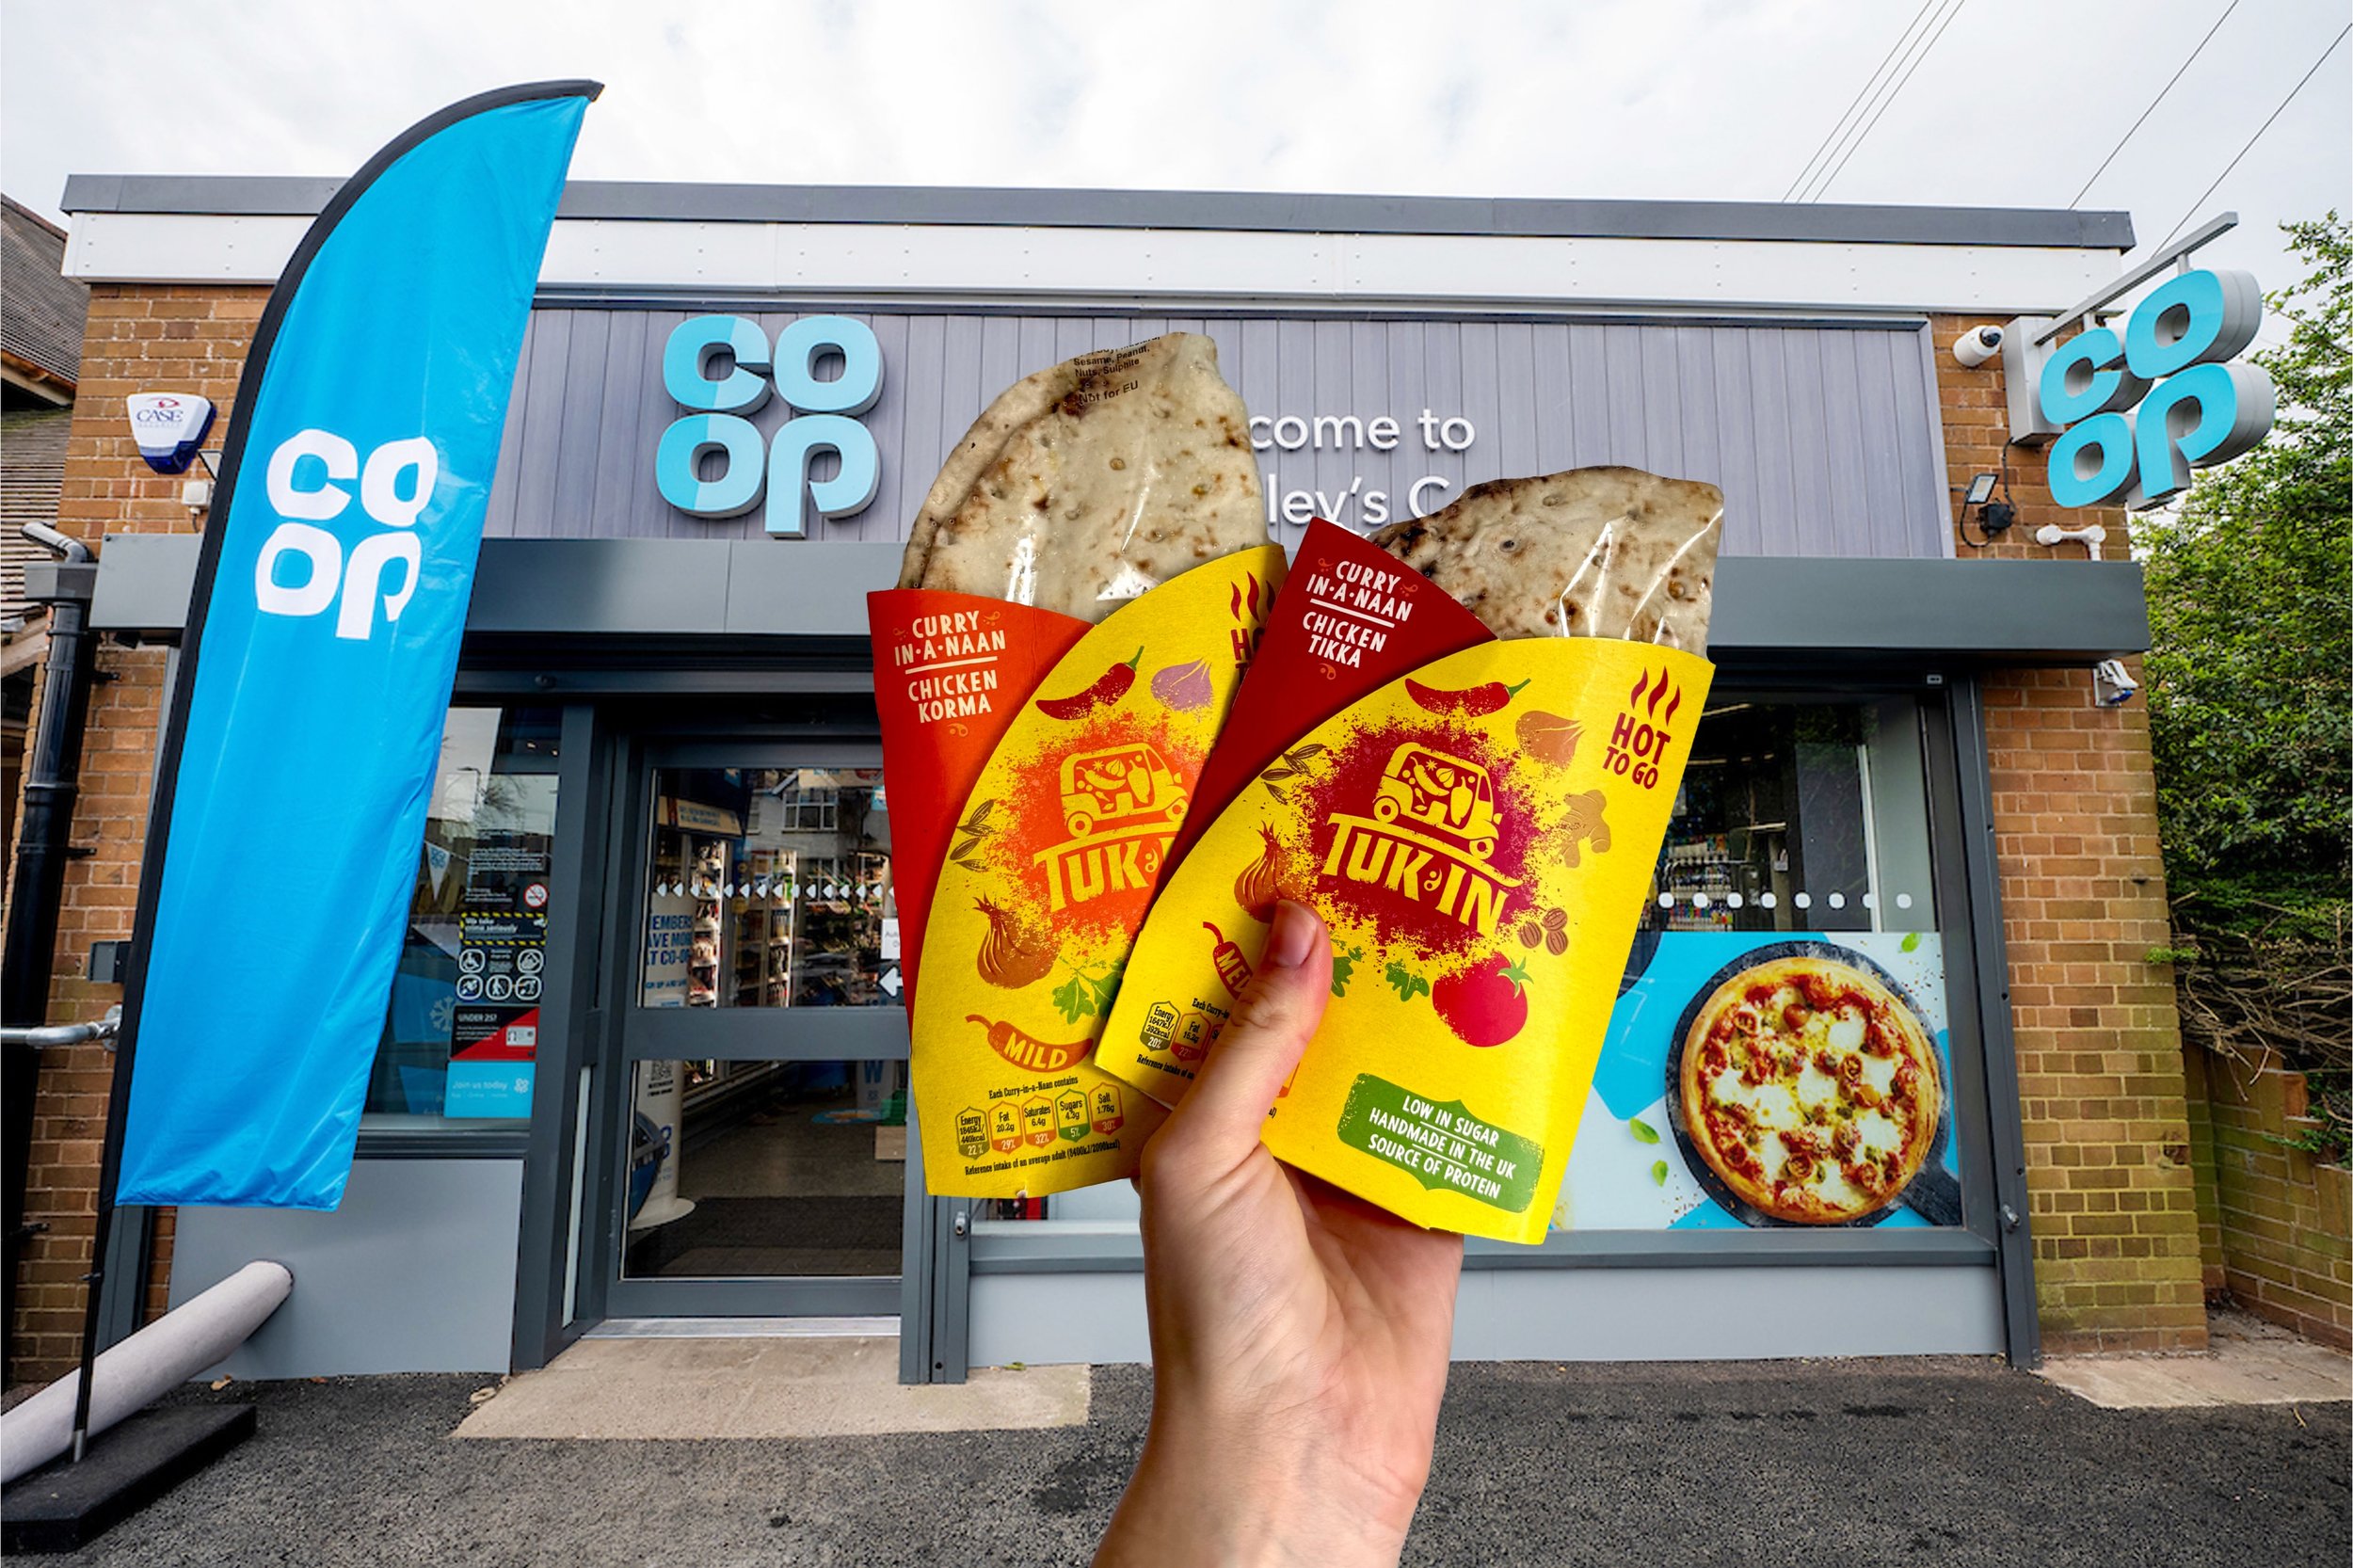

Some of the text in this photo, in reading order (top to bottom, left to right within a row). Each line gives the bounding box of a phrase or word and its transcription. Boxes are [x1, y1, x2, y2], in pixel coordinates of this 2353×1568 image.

[1103, 358, 1140, 374] Sulphite
[1079, 380, 1139, 404] Not for EU
[136, 408, 184, 423] CASE
[1417, 408, 1476, 451] to
[1336, 560, 1401, 594] CURRY
[912, 610, 980, 639] CURRY
[1303, 611, 1387, 653] CHICKEN
[1308, 633, 1361, 668] TIKKA
[907, 669, 998, 702] CHICKEN
[919, 696, 992, 724] KORMA
[1610, 712, 1672, 766] HOT
[1602, 745, 1658, 790] TO GO
[649, 915, 693, 930] EMBERS
[1154, 1005, 1175, 1023] Energy
[1192, 998, 1230, 1019] Each Curry-in
[457, 1013, 484, 1022] UNDER
[1145, 1024, 1170, 1039] 392kcal
[1189, 1021, 1201, 1033] Fat
[1147, 1036, 1162, 1049] 20%
[1003, 1032, 1069, 1070] MILD
[1136, 1053, 1163, 1069] Reference
[988, 1088, 1003, 1099] Each
[1054, 1076, 1079, 1088] contains
[1060, 1099, 1082, 1112] Sugars
[1097, 1093, 1111, 1104] Salt
[1024, 1105, 1051, 1118] Saturates
[1065, 1112, 1080, 1120] 4.3g
[1096, 1104, 1115, 1113] 1.78g
[960, 1115, 982, 1127] Energy
[999, 1112, 1010, 1122] Fat
[1031, 1118, 1046, 1127] 6.4g
[1401, 1095, 1499, 1148] LOW IN SUGAR
[996, 1123, 1015, 1133] 20.2g
[1070, 1128, 1080, 1137] 5%
[961, 1133, 985, 1144] 440kcal
[1001, 1139, 1016, 1151] 29%
[1034, 1132, 1049, 1144] 32%
[1369, 1107, 1517, 1180] HANDMADE IN THE UK
[965, 1165, 992, 1176] Reference
[993, 1160, 1012, 1172] intake
[1012, 1158, 1018, 1167] of
[1019, 1159, 1027, 1167] an
[1028, 1154, 1050, 1165] average
[1051, 1149, 1066, 1160] adult
[1368, 1133, 1502, 1200] SOURCE OF PROTEIN
